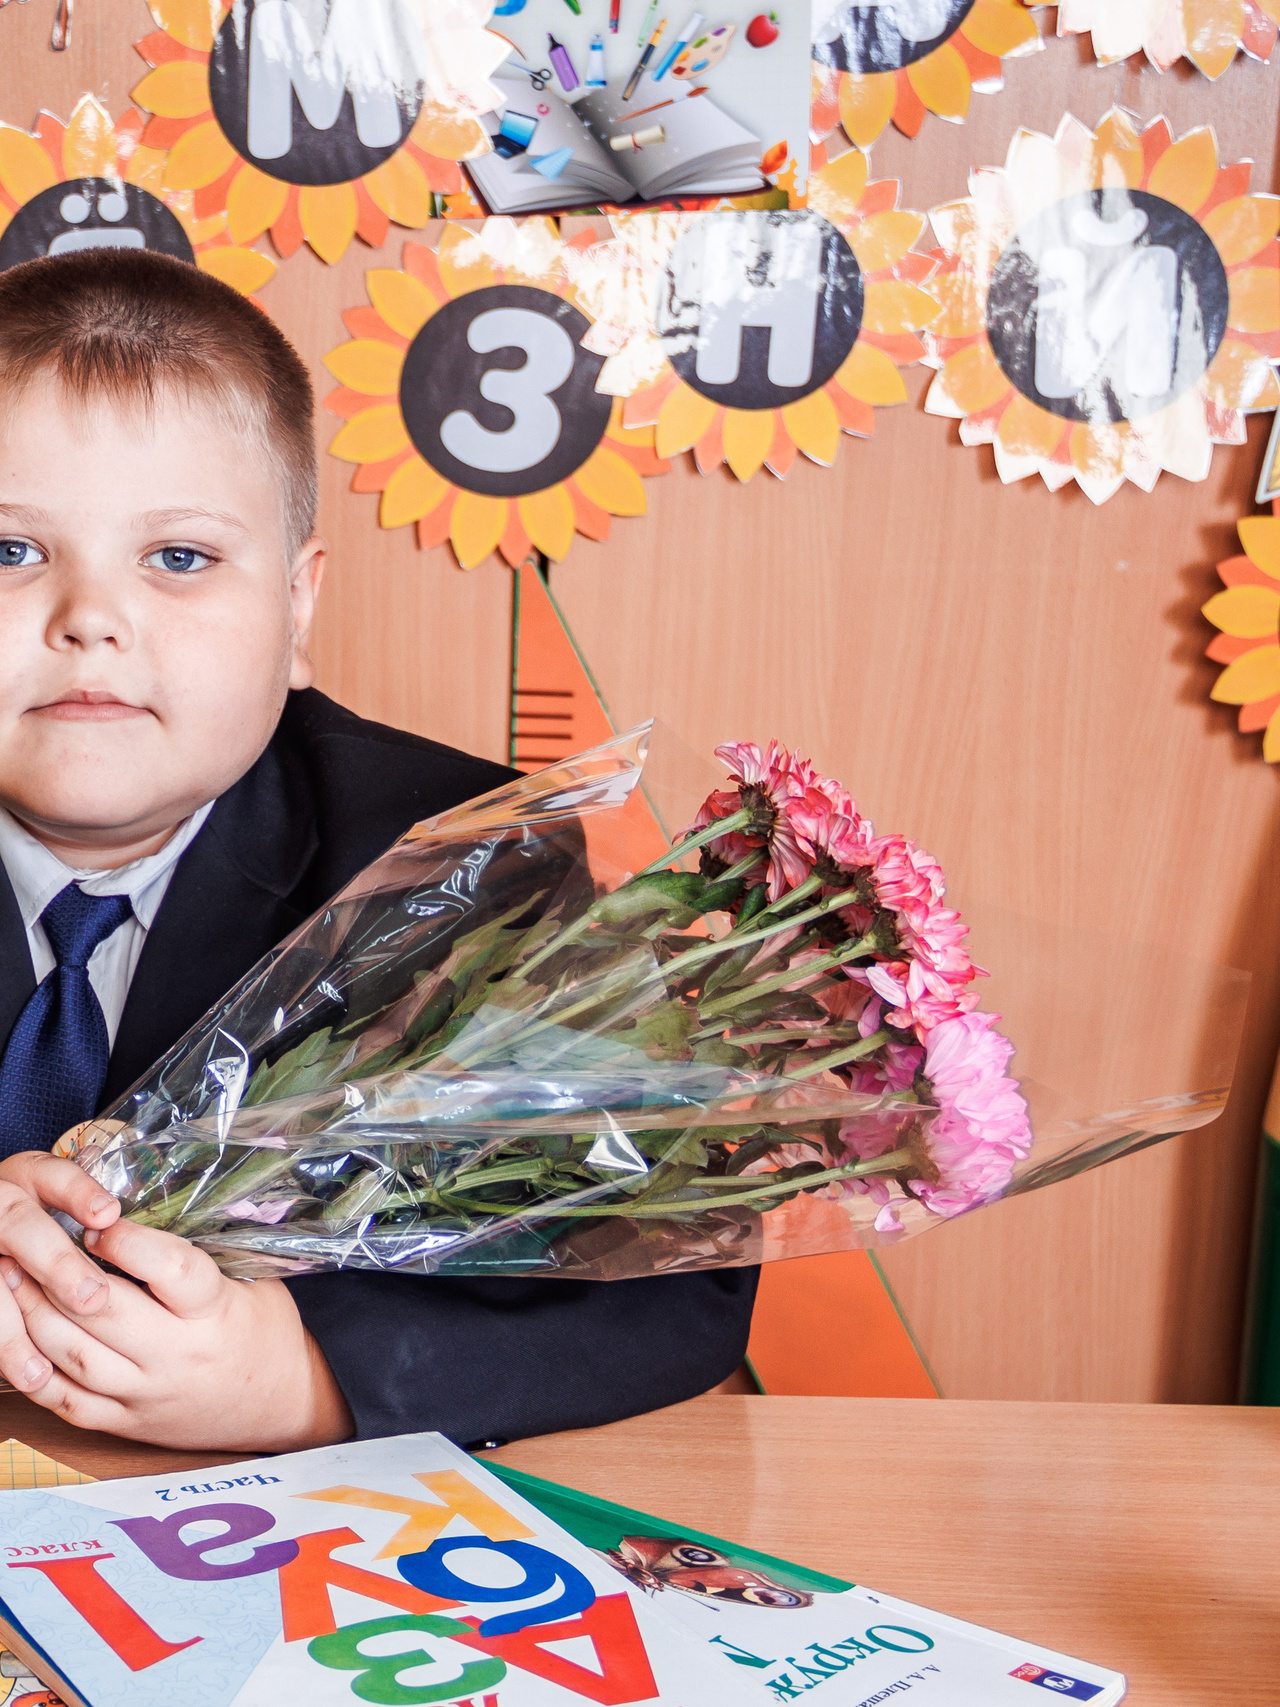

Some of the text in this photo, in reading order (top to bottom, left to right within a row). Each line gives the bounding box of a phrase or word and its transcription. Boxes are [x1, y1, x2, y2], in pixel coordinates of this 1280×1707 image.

[247, 0, 402, 160] М
[695, 222, 821, 387] Н
[1034, 207, 1178, 399] Й
[155, 1473, 284, 1502] Часть 2
[6, 1538, 103, 1558] класс
[7, 1552, 205, 1672] 1
[906, 1671, 926, 1682] А.
[921, 1663, 941, 1674] А.
